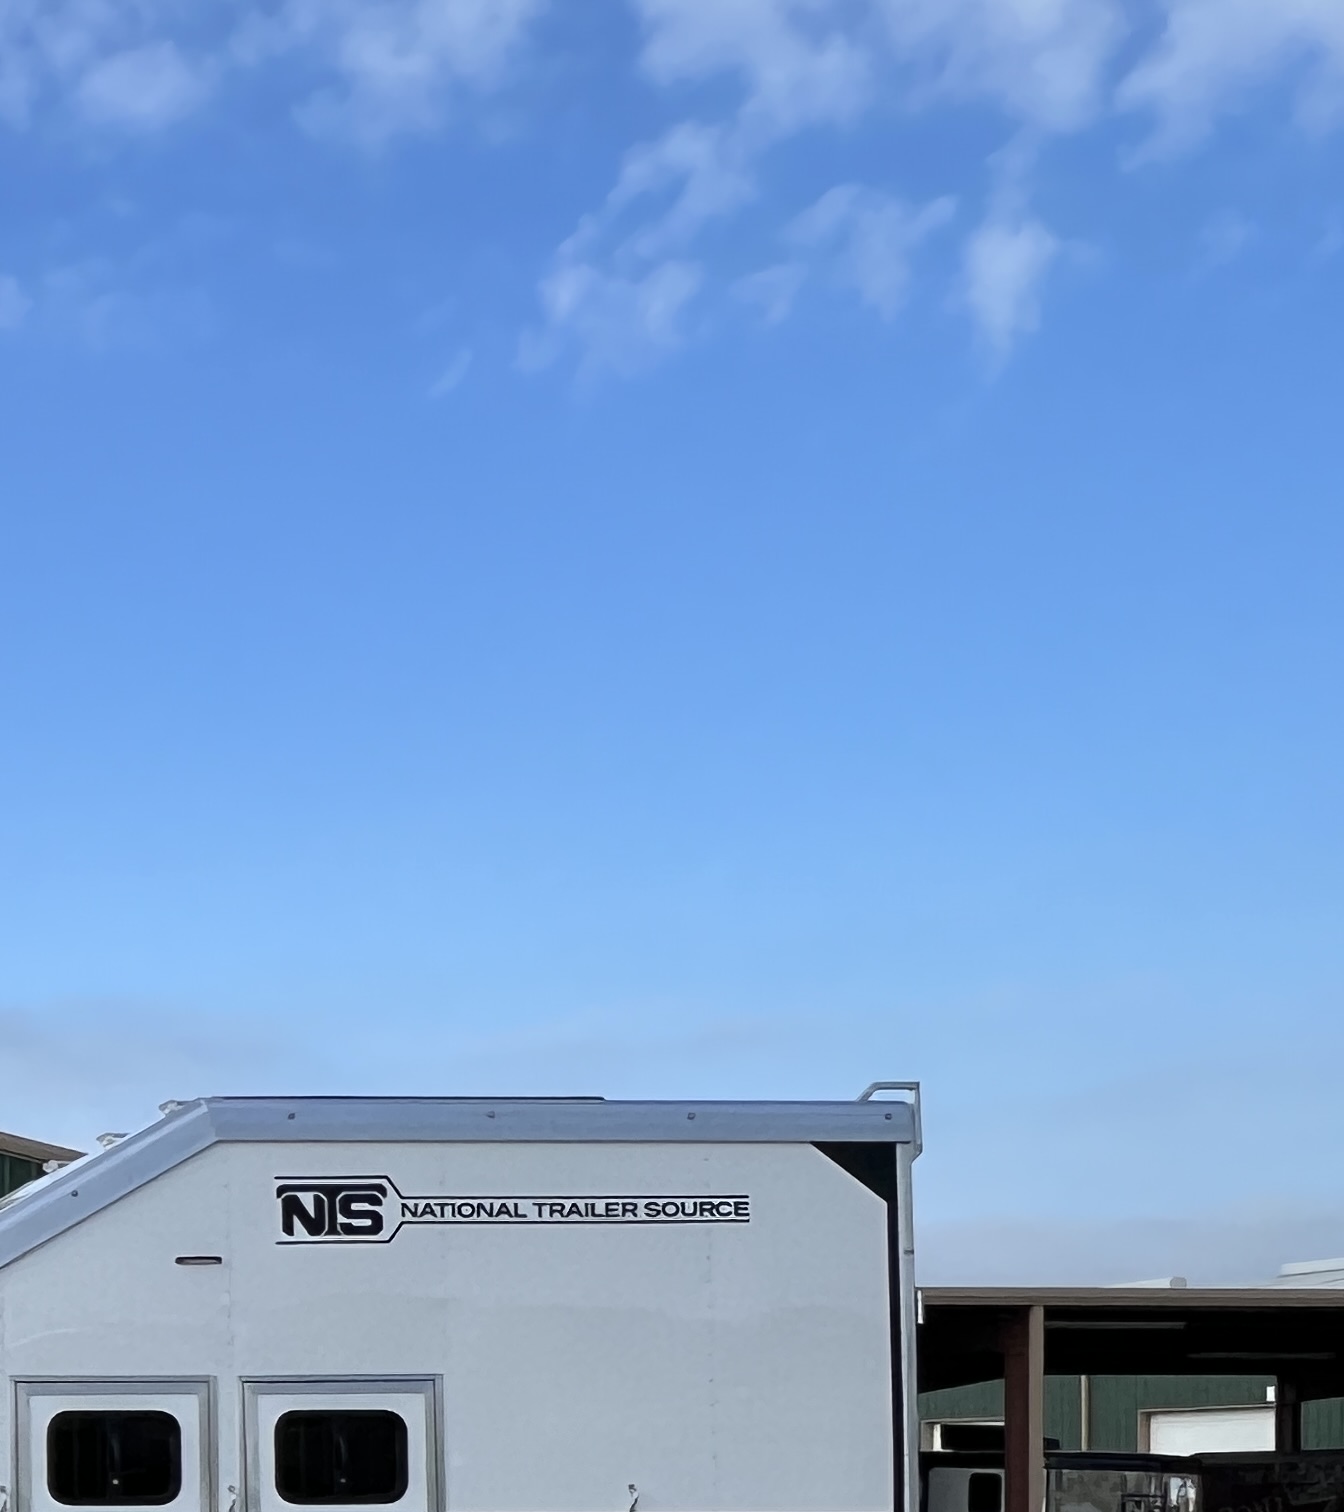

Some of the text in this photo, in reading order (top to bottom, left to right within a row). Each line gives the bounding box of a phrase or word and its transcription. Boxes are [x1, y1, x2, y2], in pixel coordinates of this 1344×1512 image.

[276, 1183, 388, 1237] NTS
[400, 1201, 750, 1219] NATIONAL TRAILER SOURCE
